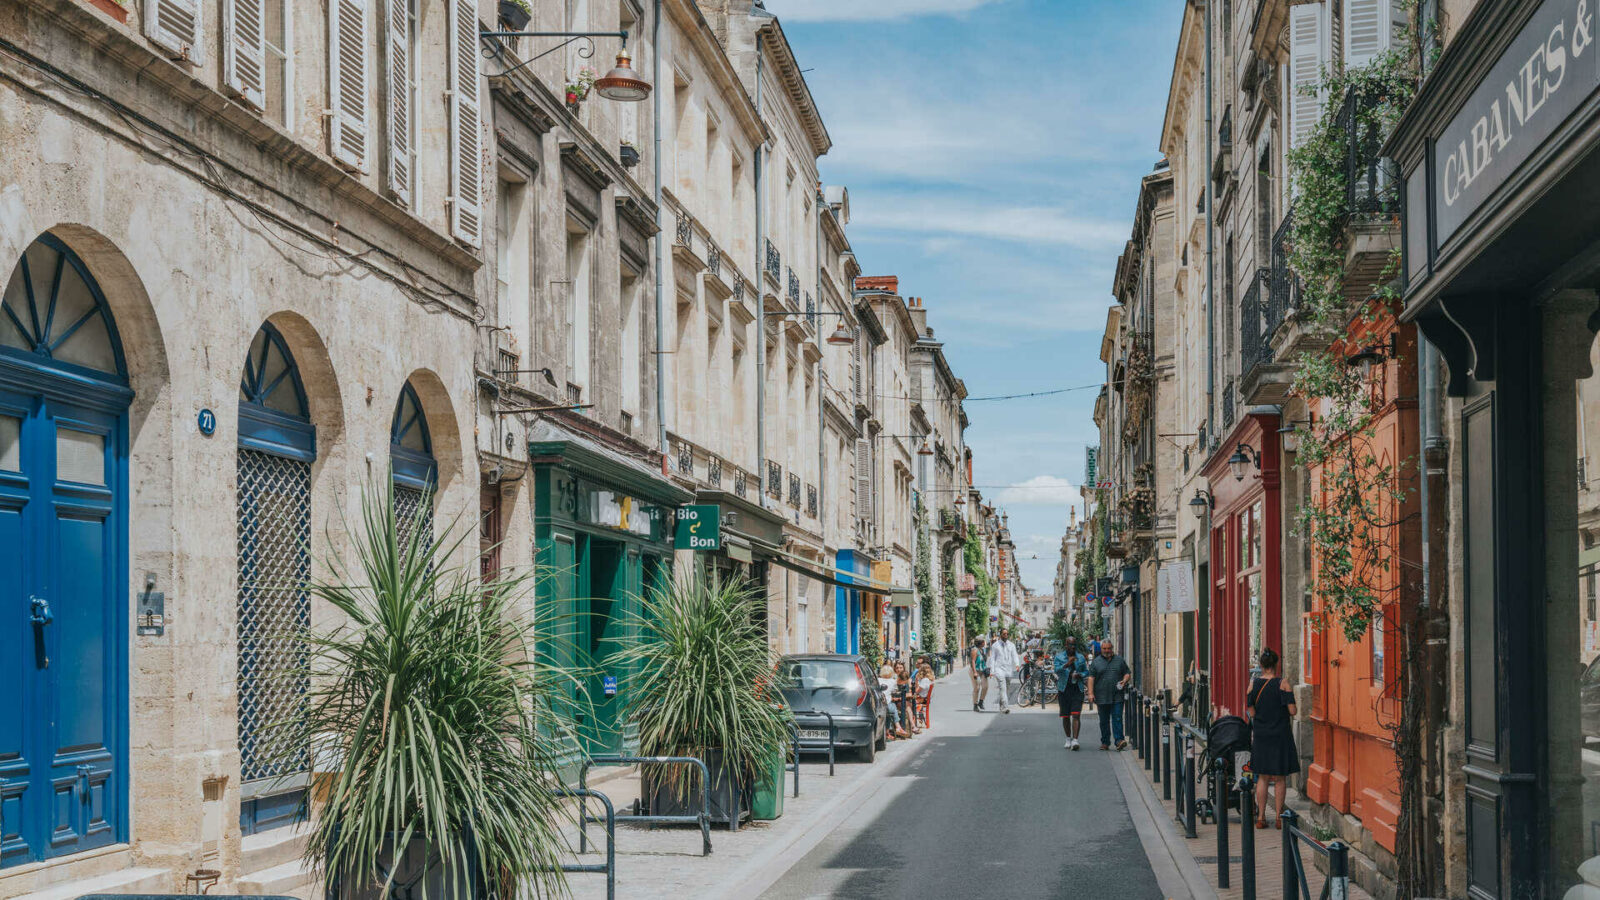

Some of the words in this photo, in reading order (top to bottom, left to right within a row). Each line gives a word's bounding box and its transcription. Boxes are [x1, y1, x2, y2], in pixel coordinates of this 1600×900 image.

[1444, 19, 1566, 206] CABANES
[1571, 0, 1593, 58] &
[203, 413, 212, 429] 71
[677, 508, 698, 520] Bio
[690, 536, 715, 547] Bon
